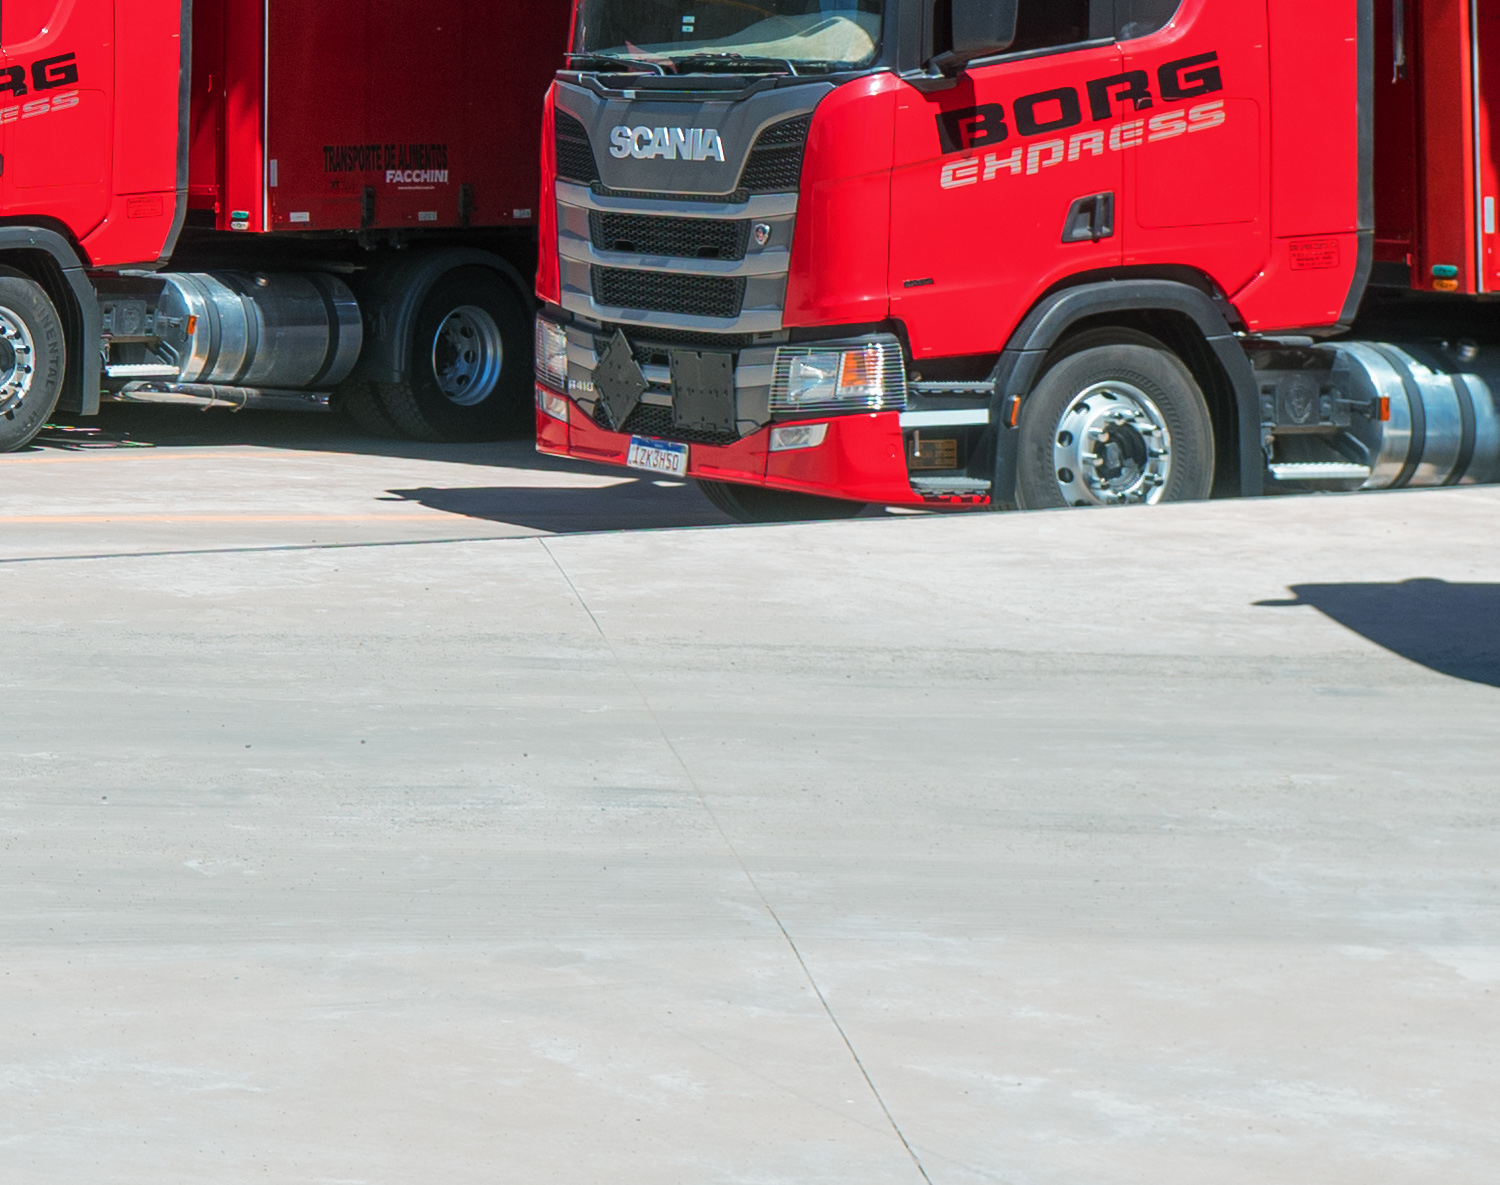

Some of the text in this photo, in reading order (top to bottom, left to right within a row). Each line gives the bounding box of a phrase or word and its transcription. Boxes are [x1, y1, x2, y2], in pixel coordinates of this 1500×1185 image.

[935, 50, 1224, 155] BORG
[323, 144, 448, 173] TRANSPORTE DE ALIMENTOS
[609, 125, 726, 162] SCANIA
[940, 99, 1226, 190] EXPRESS
[385, 169, 449, 183] FACCHINI
[568, 379, 594, 392] R410
